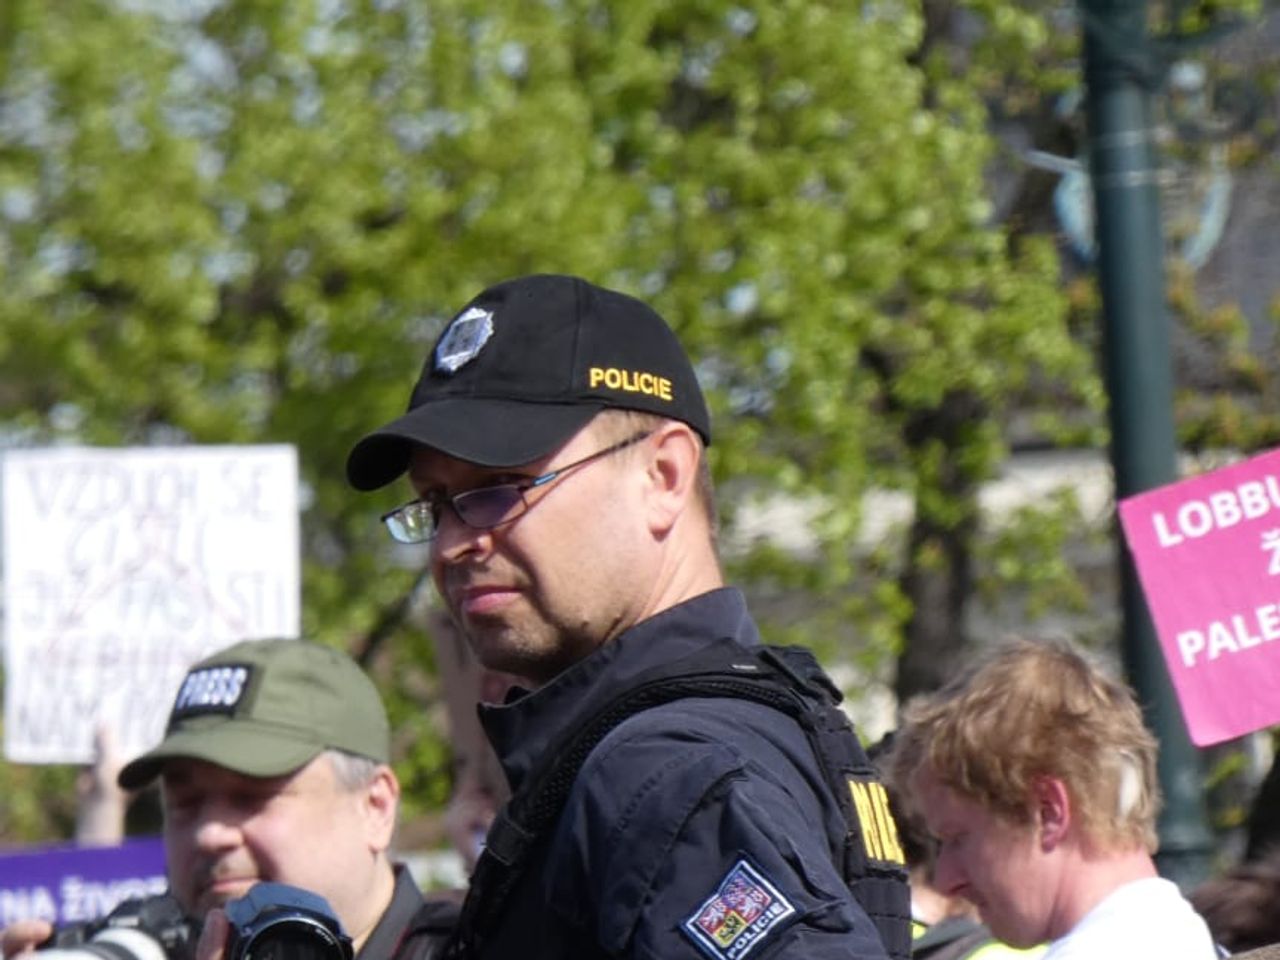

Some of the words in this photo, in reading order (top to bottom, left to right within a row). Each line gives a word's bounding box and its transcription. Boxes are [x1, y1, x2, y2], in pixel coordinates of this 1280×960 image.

[589, 367, 673, 401] POLICIE
[176, 667, 247, 708] PRESS
[726, 902, 785, 959] POLICIE
